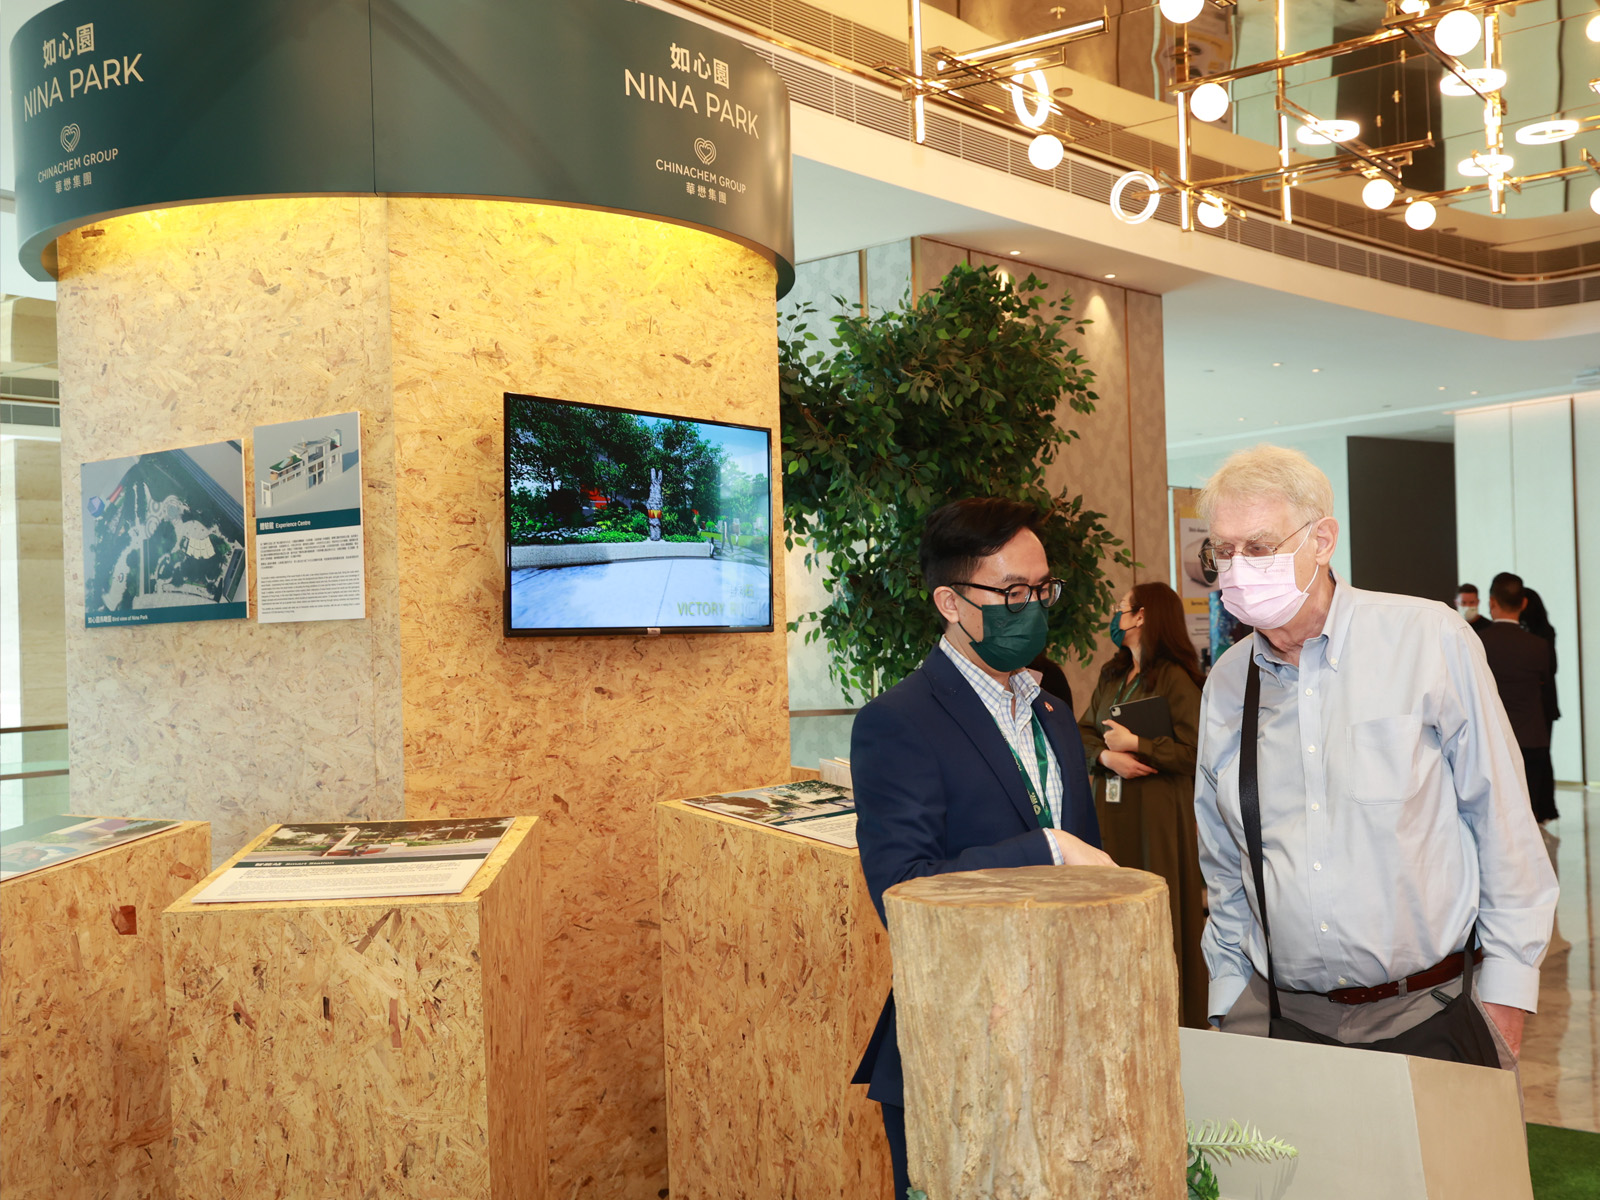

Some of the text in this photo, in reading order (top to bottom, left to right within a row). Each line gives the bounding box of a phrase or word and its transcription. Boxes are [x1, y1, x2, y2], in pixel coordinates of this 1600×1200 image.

[42, 22, 95, 69] 如心園
[669, 42, 730, 89] 如心園
[23, 53, 144, 122] NINA PARK
[624, 68, 760, 140] NINA PARK
[37, 147, 119, 184] CHINACHEM GROUP
[54, 171, 92, 195] 華懋集團
[655, 158, 747, 195] CHINACHEM GROUP
[686, 181, 727, 206] 華懋集團
[677, 601, 724, 616] VICTORY
